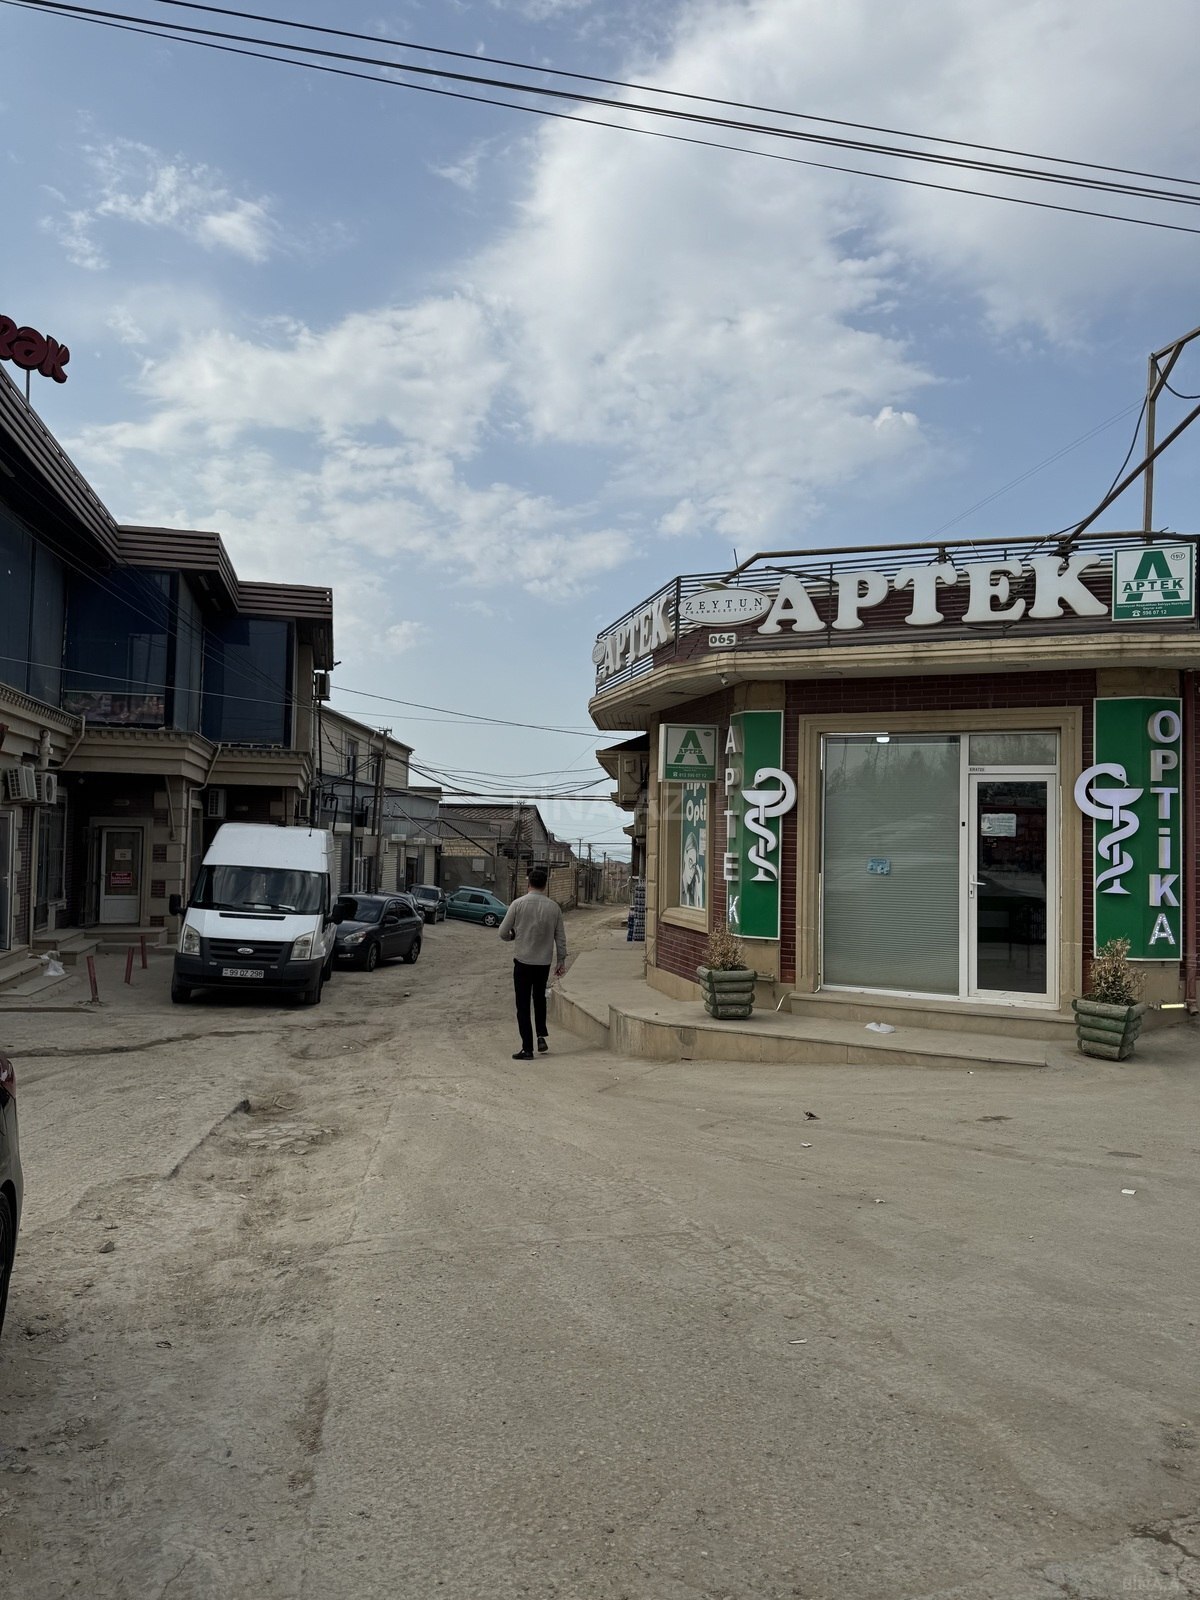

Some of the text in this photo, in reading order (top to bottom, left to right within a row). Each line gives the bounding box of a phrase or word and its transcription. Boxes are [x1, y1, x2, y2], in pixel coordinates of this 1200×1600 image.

[1123, 579, 1184, 592] APTEK
[757, 554, 1109, 635] APTEK
[685, 597, 763, 611] ZEYTUN
[685, 606, 763, 615] PHARMACEUTICALS
[602, 596, 673, 678] APTEK
[709, 635, 735, 645] 065
[723, 725, 742, 924] APTEK
[250, 970, 263, 978] 298
